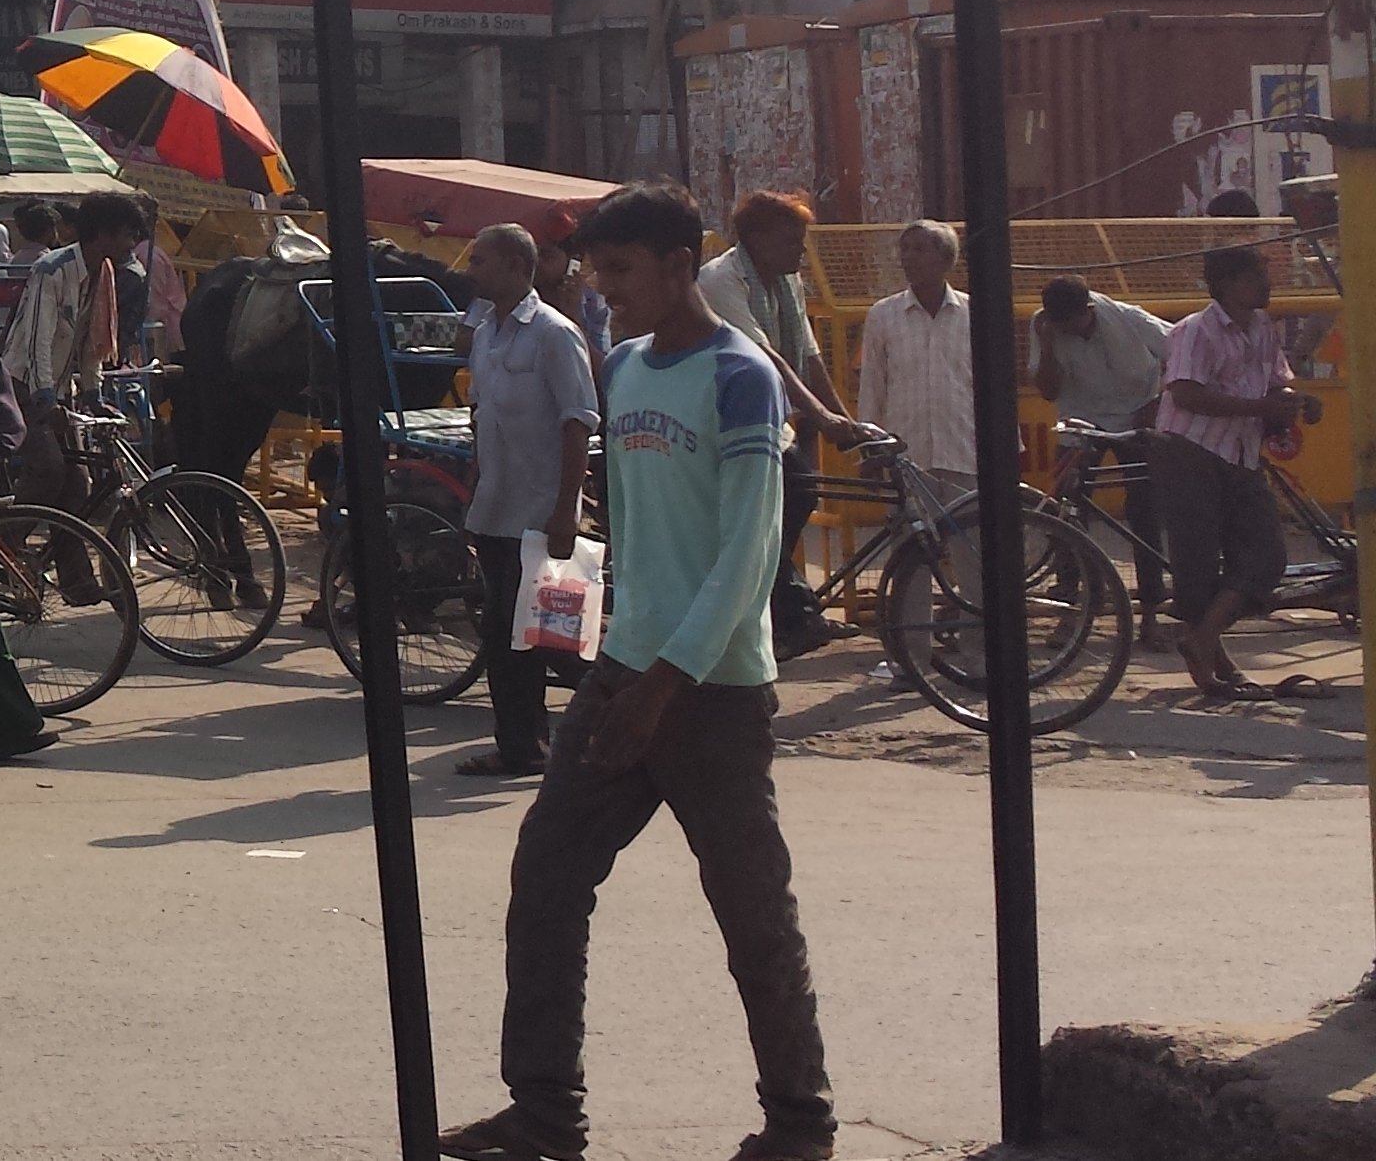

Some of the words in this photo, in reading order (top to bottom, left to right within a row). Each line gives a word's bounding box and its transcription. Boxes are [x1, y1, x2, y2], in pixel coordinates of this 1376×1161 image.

[397, 13, 420, 28] Om
[423, 14, 476, 29] Prakash
[480, 16, 489, 29] &
[494, 16, 527, 31] Sons
